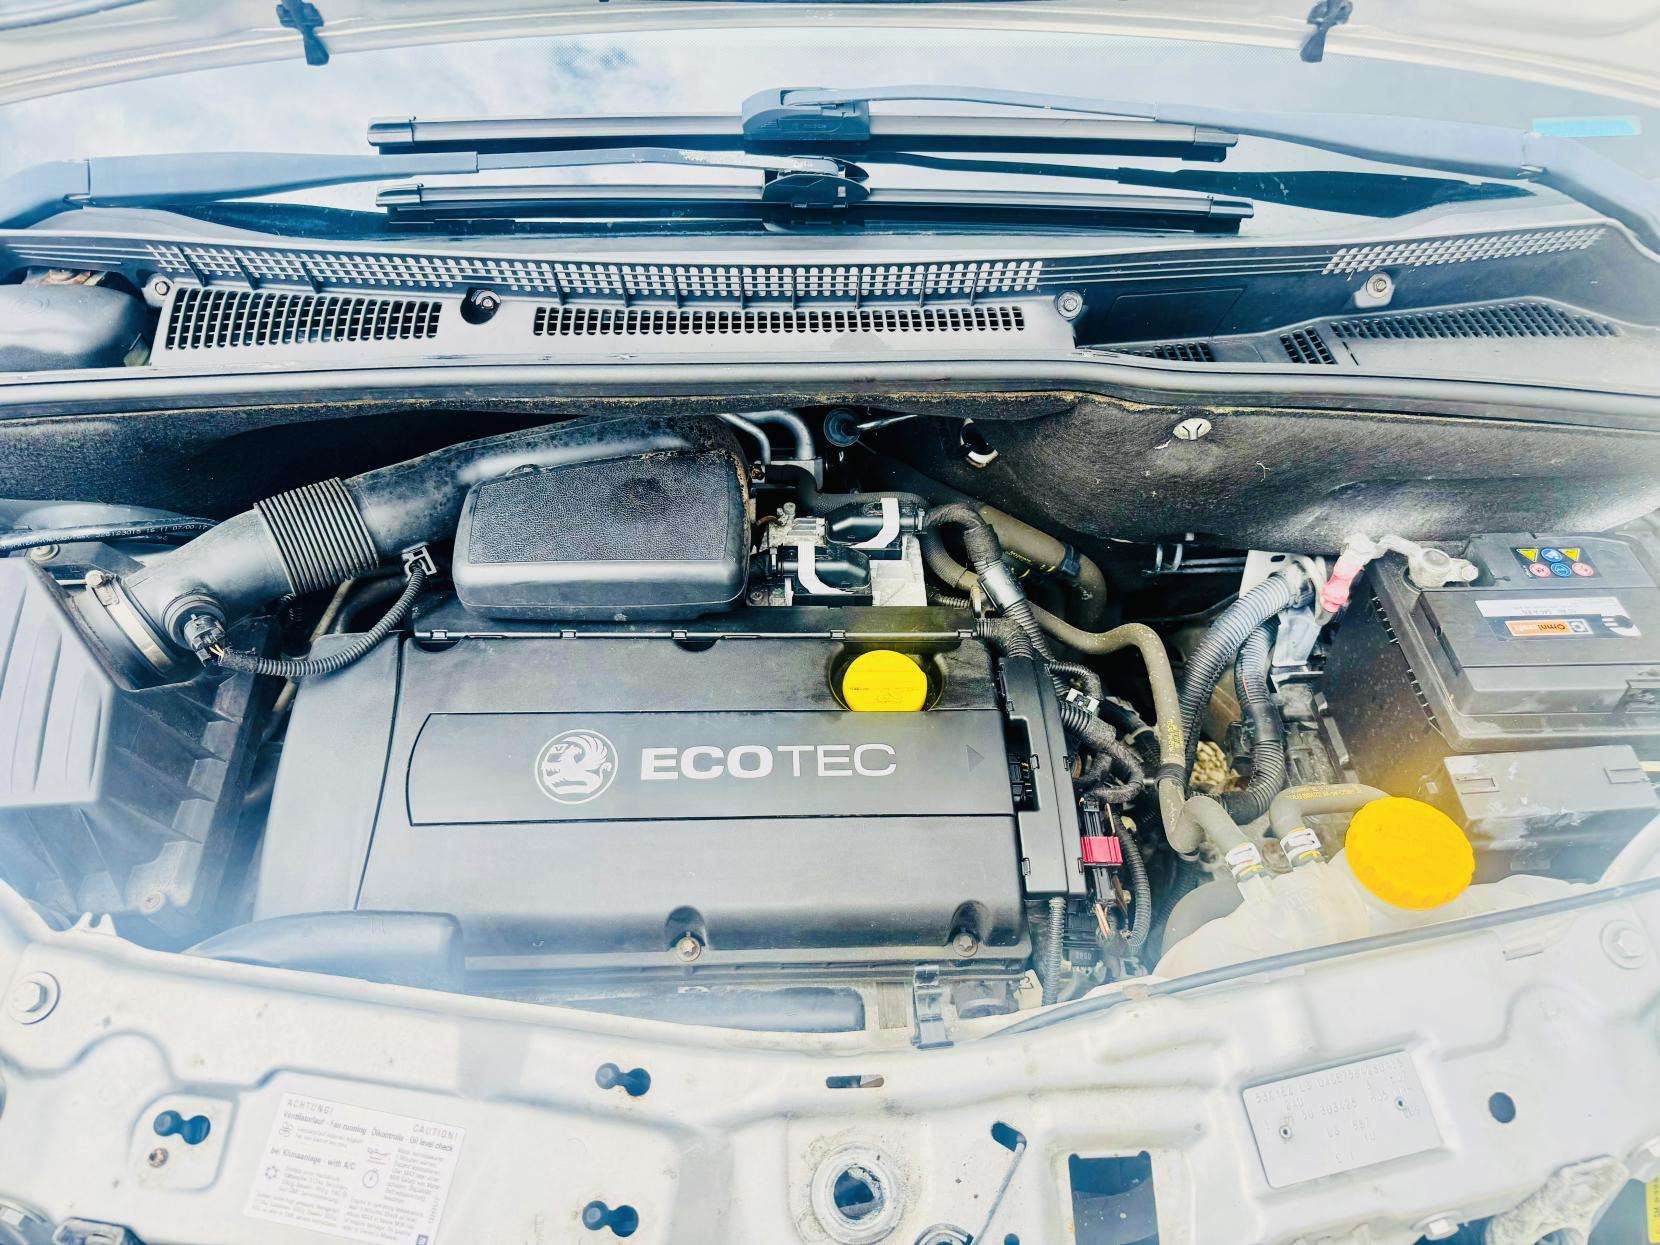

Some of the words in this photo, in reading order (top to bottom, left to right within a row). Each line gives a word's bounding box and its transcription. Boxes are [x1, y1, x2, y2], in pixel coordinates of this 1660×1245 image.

[641, 743, 897, 781] ECOTEC
[287, 1099, 334, 1114] ACHTUNG!
[342, 1122, 367, 1136] running
[419, 1138, 434, 1149] level
[434, 1142, 454, 1152] check
[412, 1124, 459, 1140] CAUTION!
[282, 1148, 322, 1164] Klimaanlage
[327, 1157, 342, 1168] with
